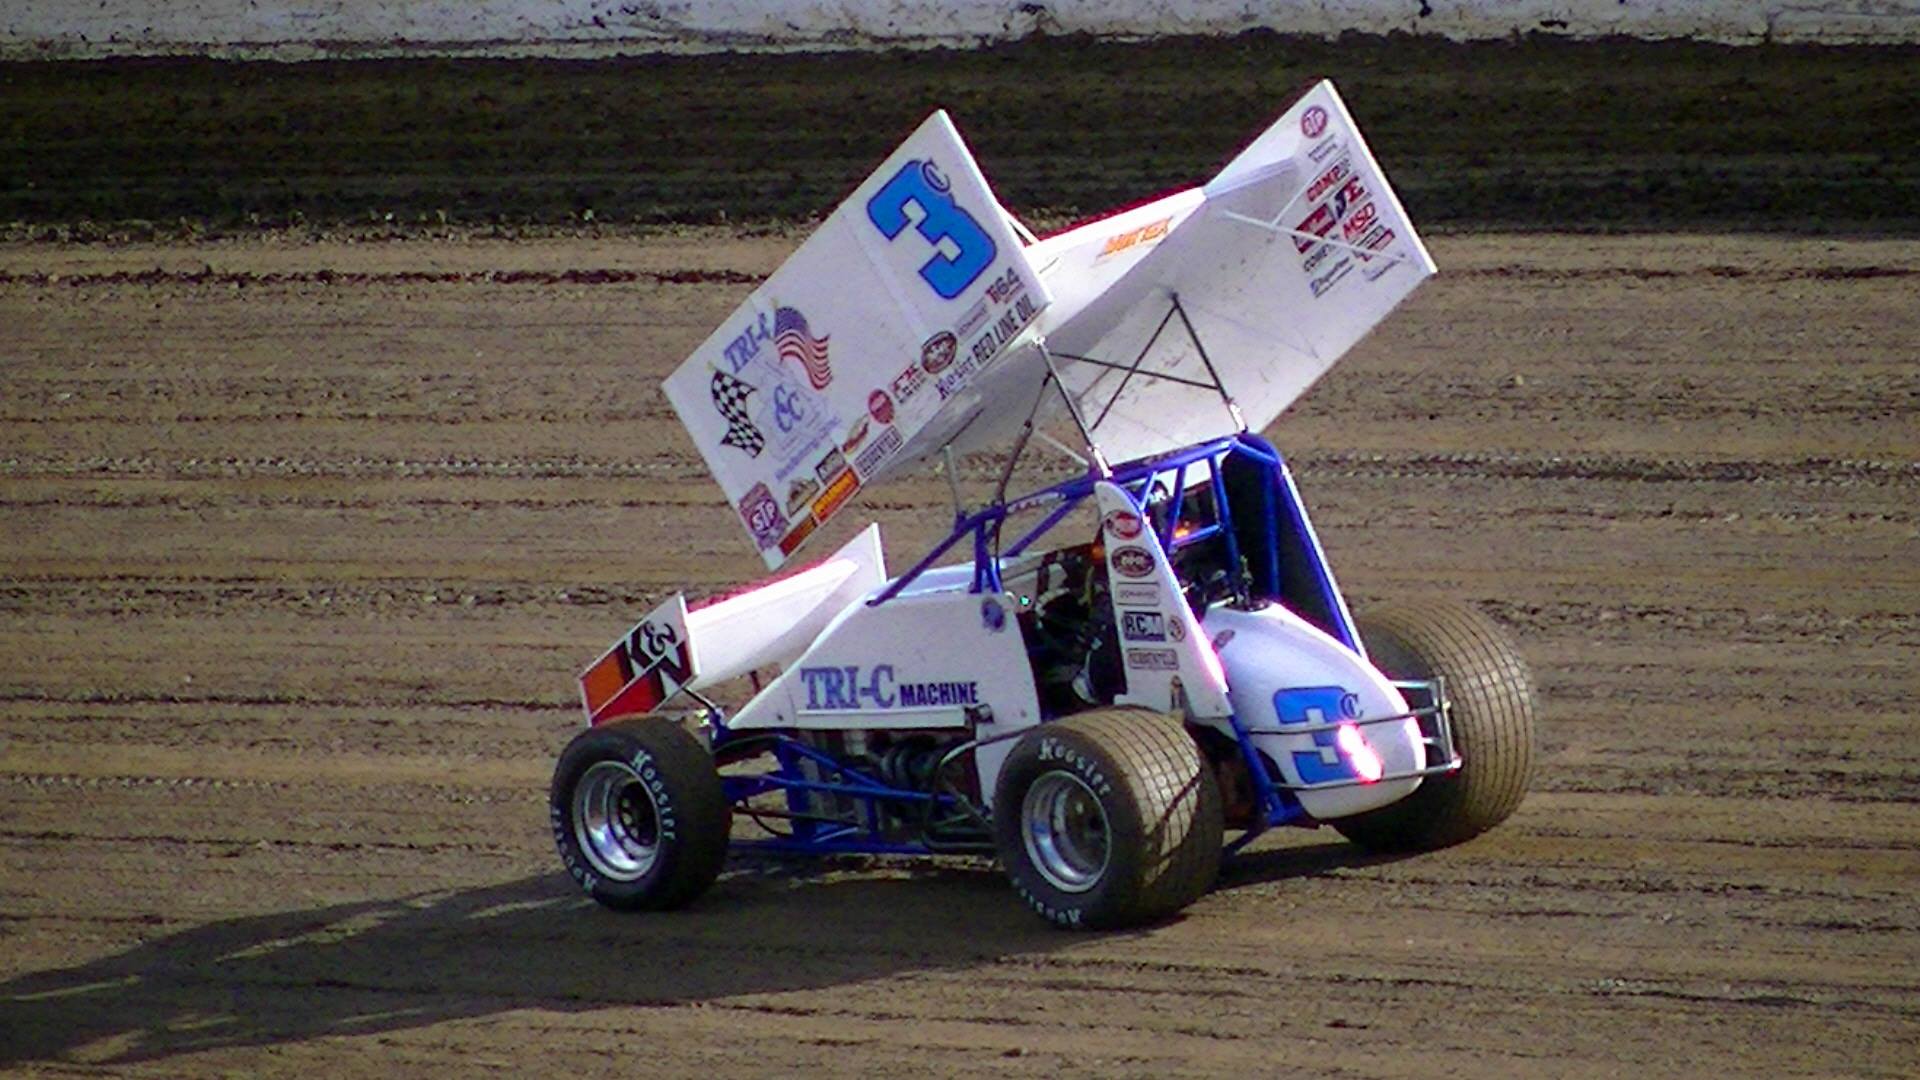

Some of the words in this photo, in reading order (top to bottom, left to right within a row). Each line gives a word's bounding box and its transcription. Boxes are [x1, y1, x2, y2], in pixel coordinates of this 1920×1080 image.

[867, 159, 997, 300] 3
[972, 331, 997, 364] RED
[994, 308, 1020, 345] LINE
[1015, 293, 1037, 322] OIL
[751, 499, 778, 531] STP
[800, 664, 895, 710] TRI-C
[899, 680, 979, 706] MACHINE
[1037, 737, 1112, 796] Hoosier
